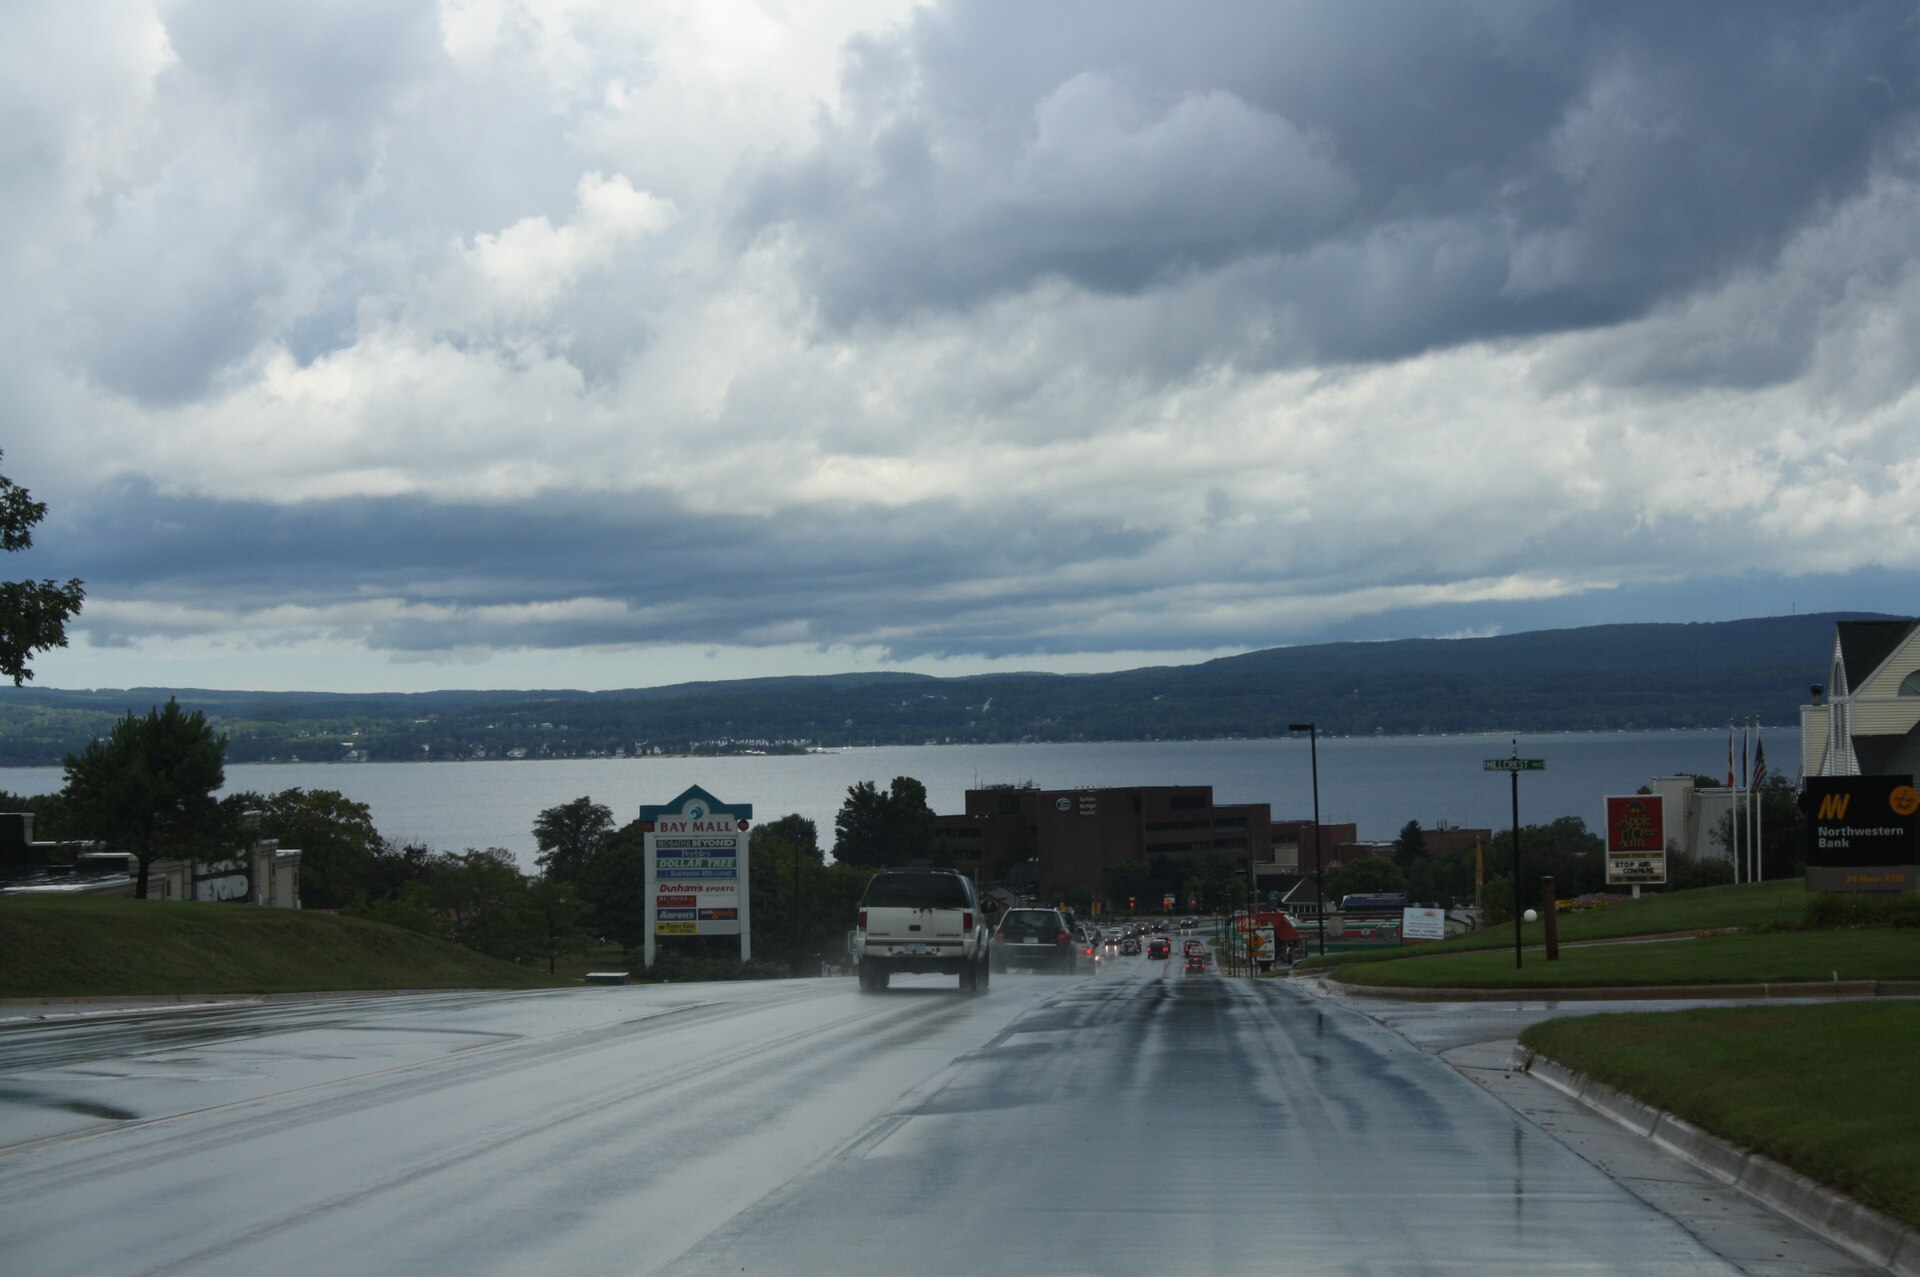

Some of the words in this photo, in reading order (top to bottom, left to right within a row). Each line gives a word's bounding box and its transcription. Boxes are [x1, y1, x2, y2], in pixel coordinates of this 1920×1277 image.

[1487, 760, 1528, 769] HILLCREST
[660, 822, 687, 832] BAY
[693, 822, 732, 832] MALL
[1818, 826, 1904, 836] Northwestern
[1818, 838, 1850, 848] Bank
[659, 859, 703, 868] DOLLAR
[708, 859, 734, 868] TREE
[659, 884, 705, 892] Dunham's
